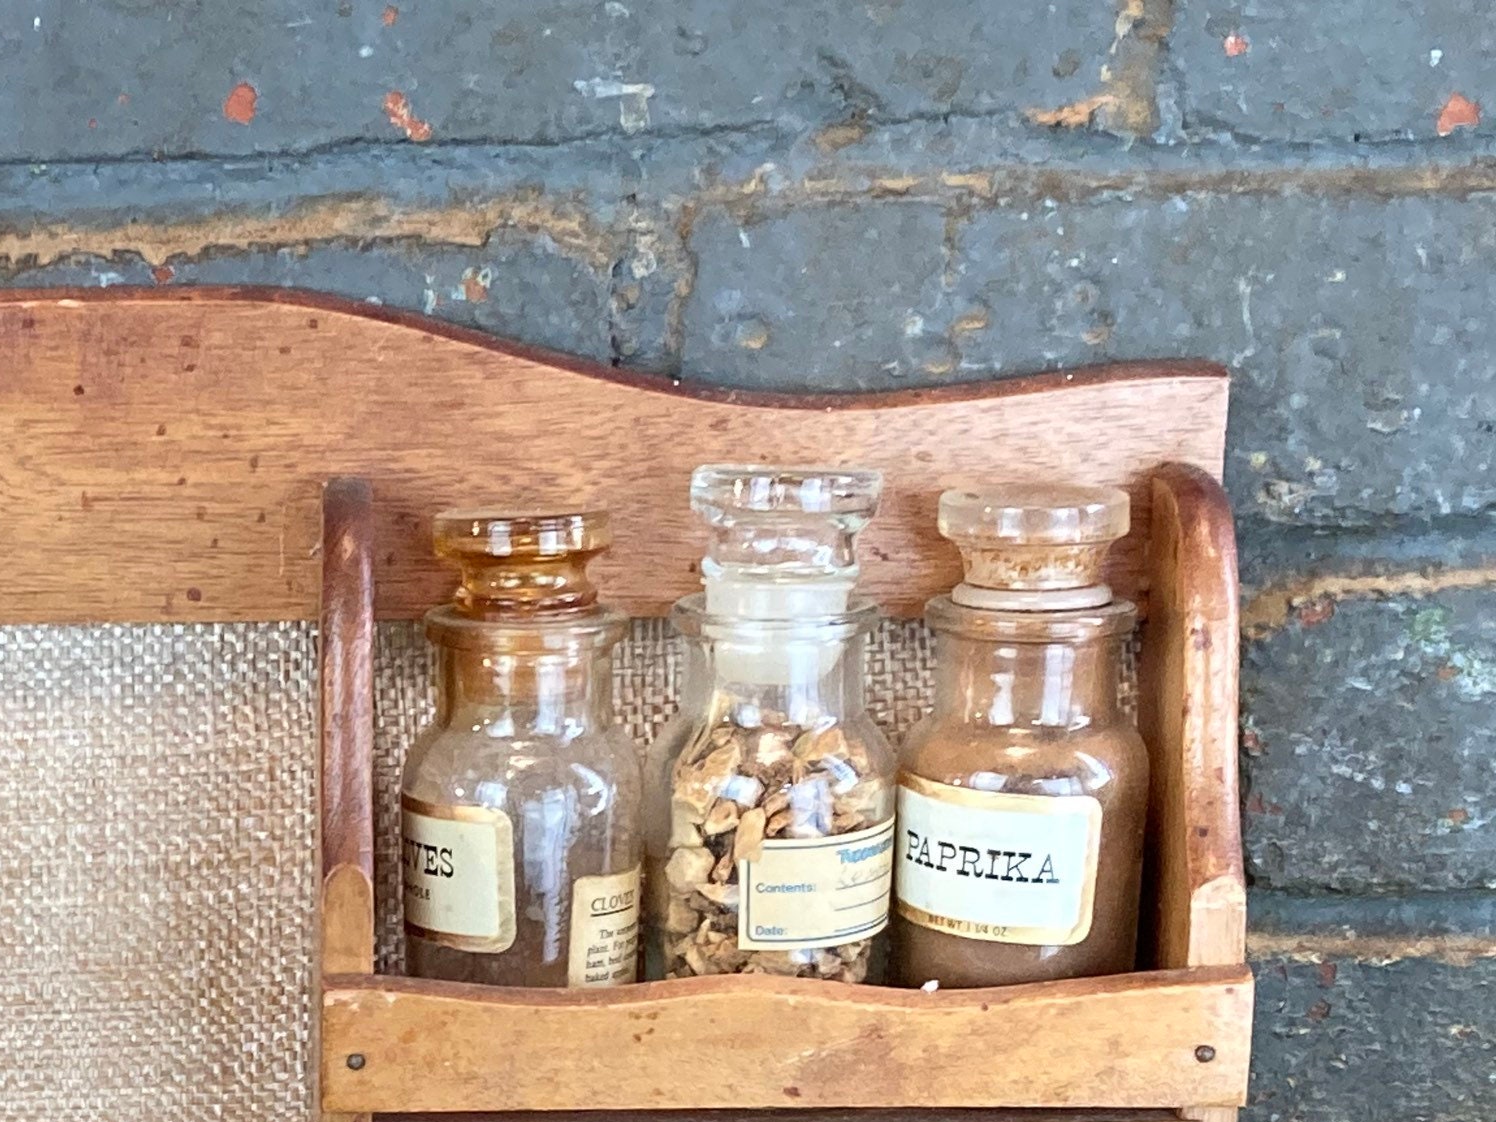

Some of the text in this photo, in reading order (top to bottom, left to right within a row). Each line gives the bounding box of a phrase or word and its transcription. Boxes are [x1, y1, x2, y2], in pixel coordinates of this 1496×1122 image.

[905, 830, 1060, 884] PAPRIKA
[755, 882, 817, 894] Contents:
[755, 926, 788, 937] Date:
